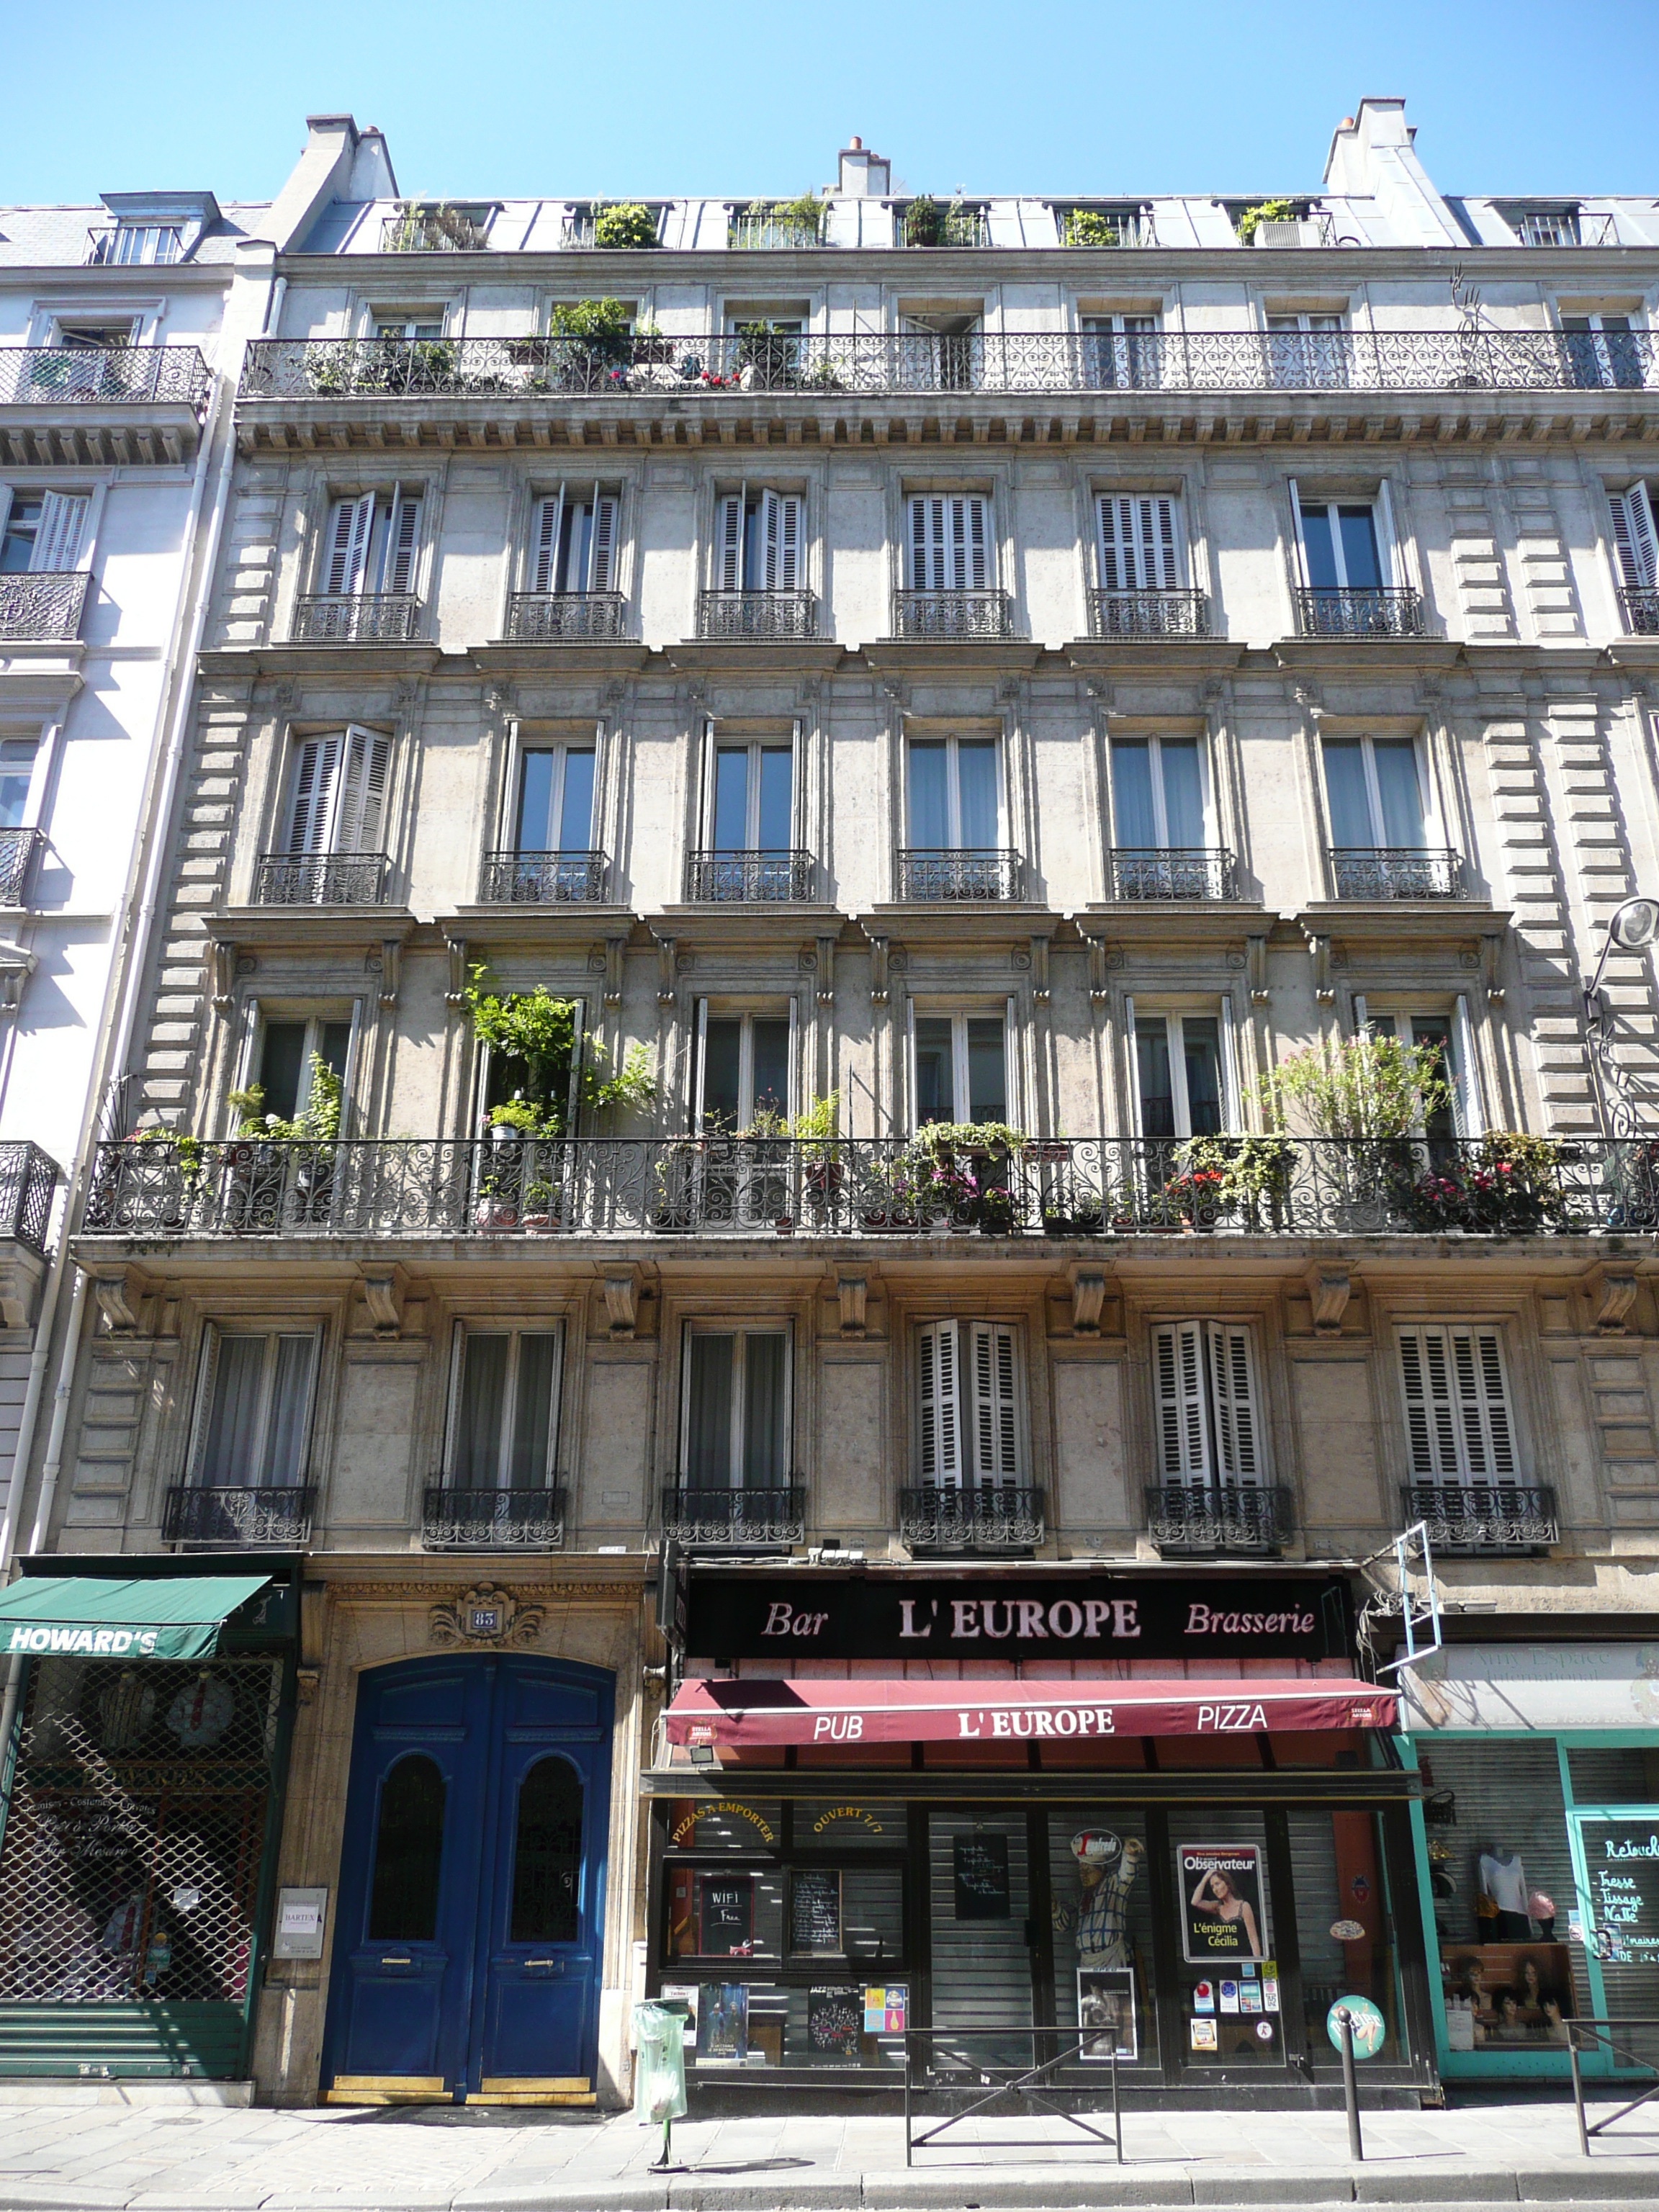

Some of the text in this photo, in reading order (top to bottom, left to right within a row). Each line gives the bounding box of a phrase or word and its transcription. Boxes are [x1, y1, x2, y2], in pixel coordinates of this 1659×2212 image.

[760, 1602, 829, 1636] Bar
[899, 1599, 1142, 1639] L'EUROPE
[1184, 1603, 1316, 1634] Brasserie
[9, 1627, 158, 1655] HOWARD'S
[1528, 1647, 1610, 1668] Espace
[814, 1715, 863, 1740] PUB
[958, 1709, 1115, 1737] L'EUROPE
[1197, 1705, 1268, 1730] PIZZA
[672, 1808, 705, 1843] PIZZAS
[719, 1802, 774, 1843] EMPORTER
[813, 1807, 884, 1834] OUVERT 7/7
[1184, 1856, 1255, 1870] Observateur
[1598, 1870, 1637, 1889] Tresse
[1600, 1888, 1644, 1912] Tissage
[721, 1909, 741, 1922] Free
[1604, 1905, 1638, 1923] Natte
[1193, 1922, 1237, 1936] L'énigme
[1208, 1935, 1238, 1946] Cécilia
[1620, 1951, 1633, 1963] DE
